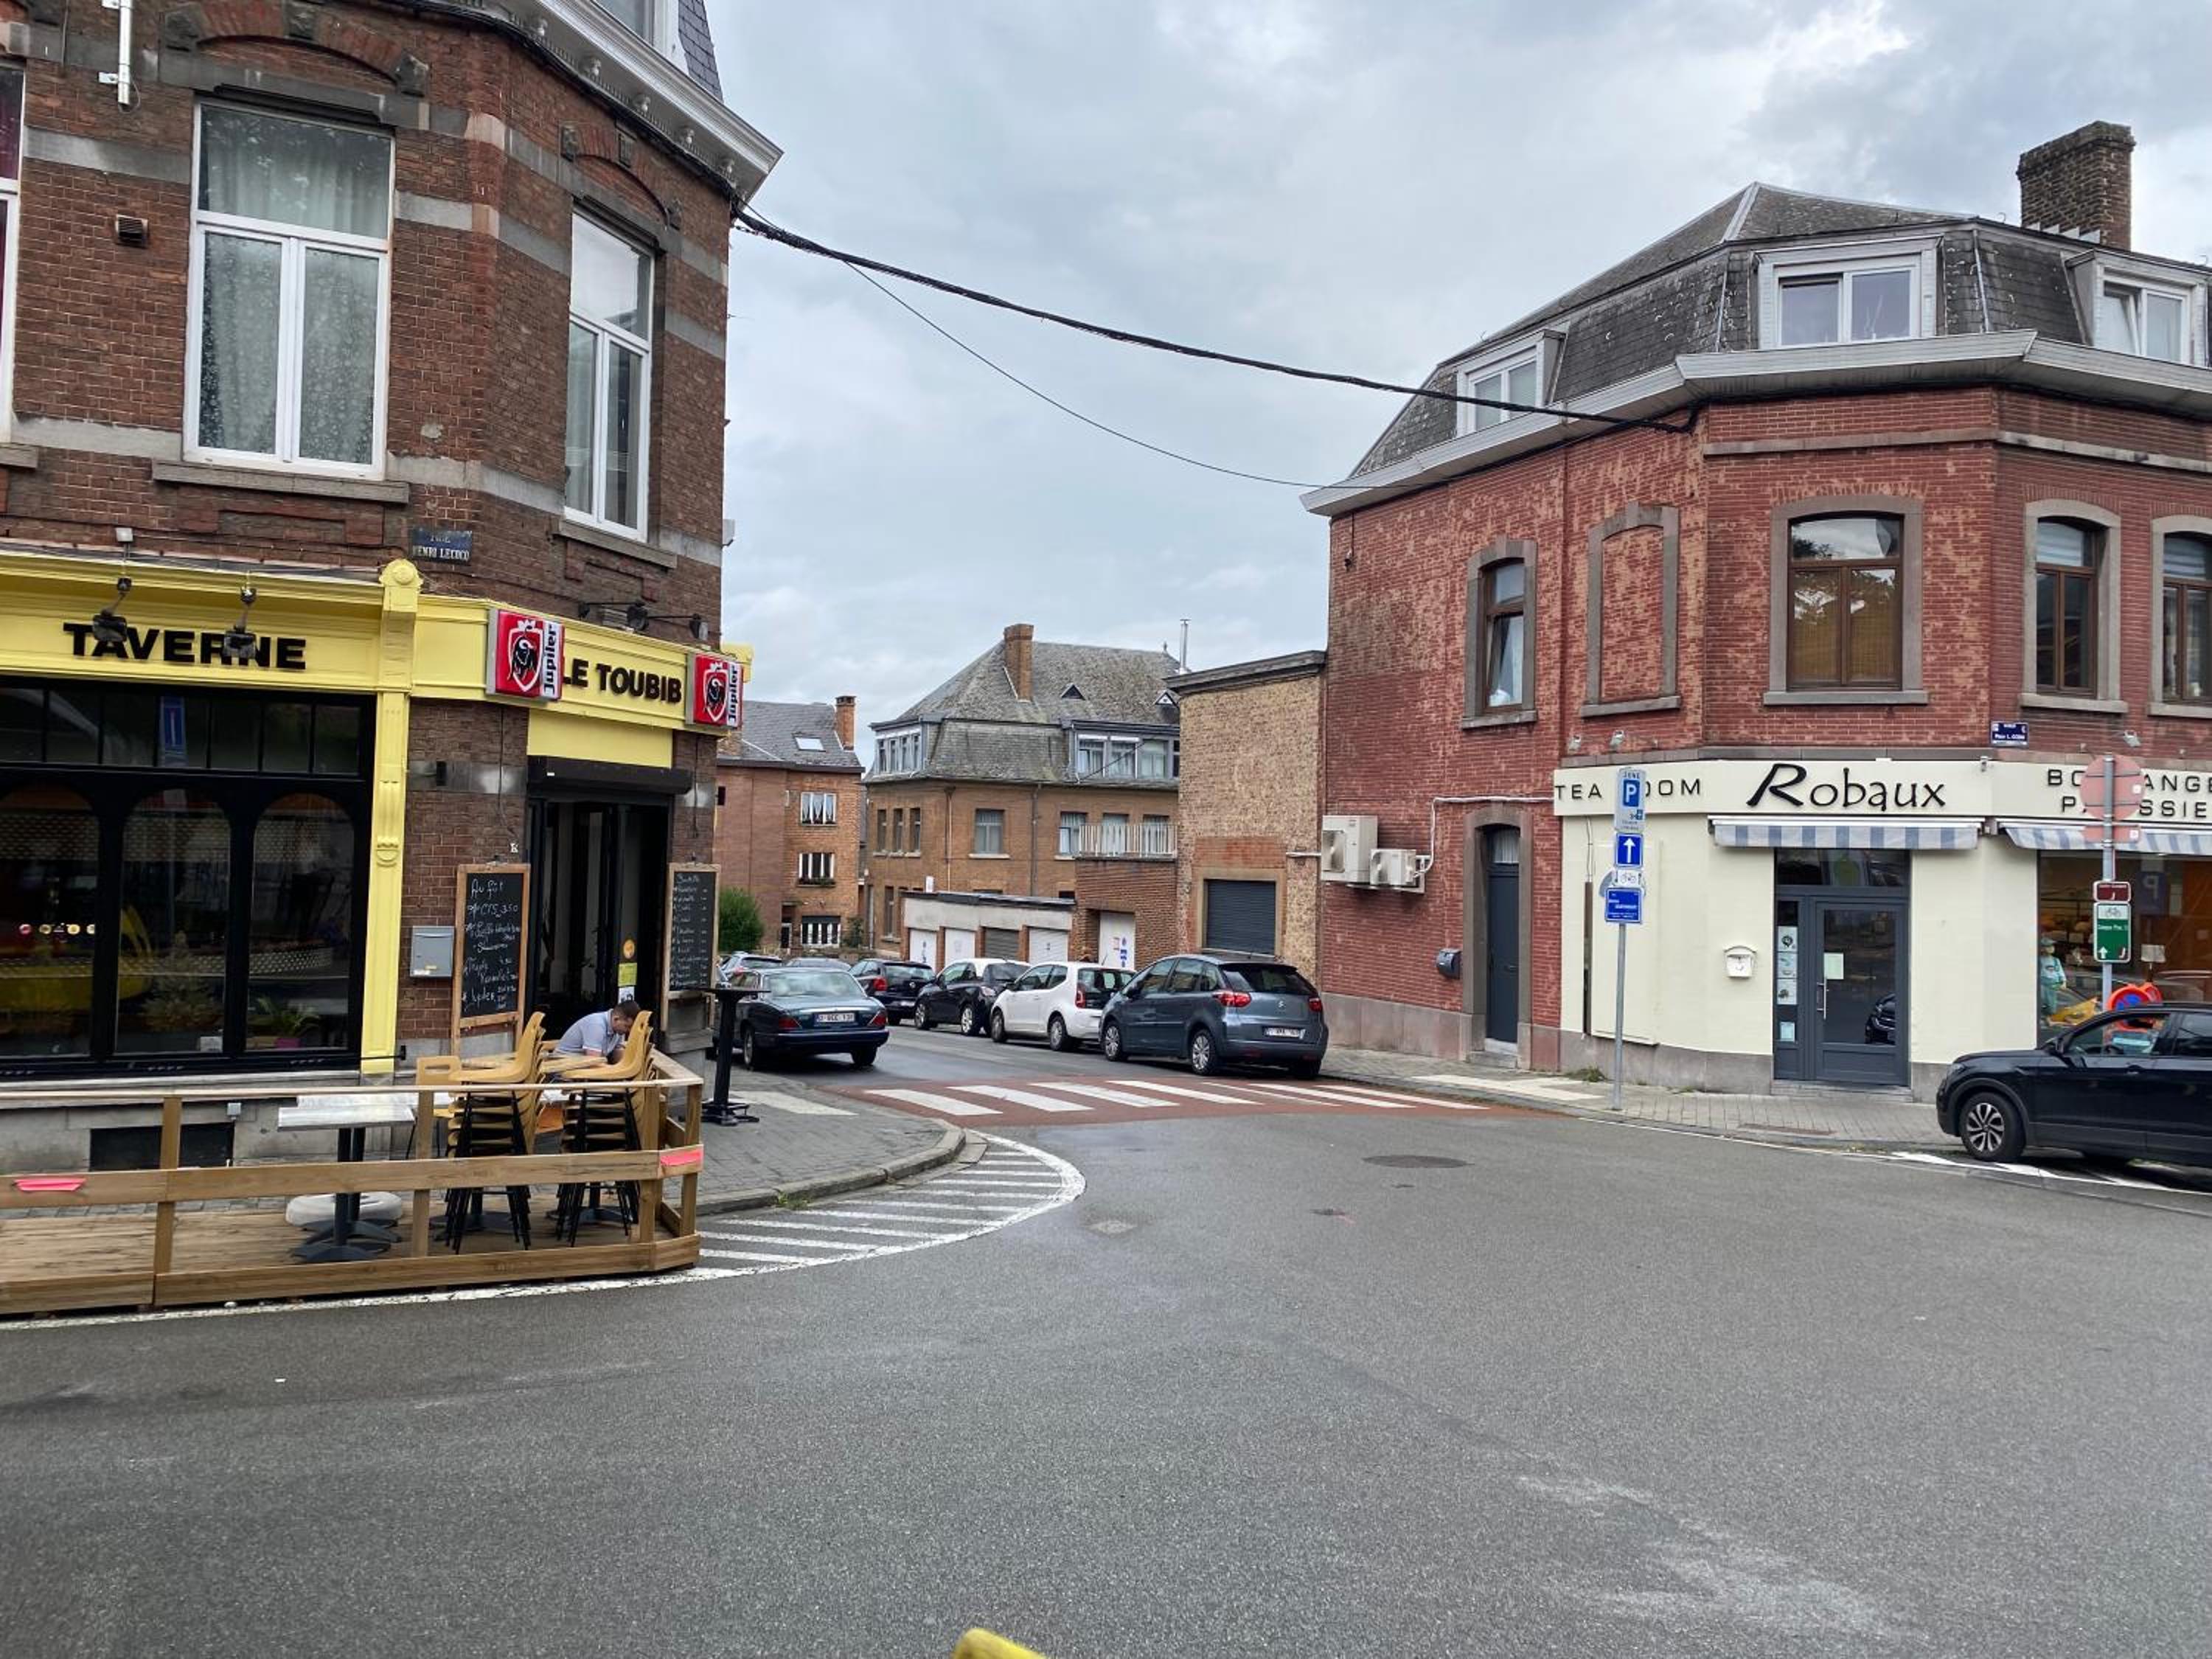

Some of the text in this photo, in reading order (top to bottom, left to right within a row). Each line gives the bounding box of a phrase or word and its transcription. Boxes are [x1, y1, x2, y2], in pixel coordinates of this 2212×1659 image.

[544, 624, 557, 695] Jupiler
[596, 664, 682, 703] TOUBIB
[728, 665, 737, 723] Jupiler
[1554, 783, 1602, 799] TEA
[1626, 782, 1637, 803] P
[1746, 763, 1946, 812] Robaux
[2062, 796, 2207, 818] PSSIE
